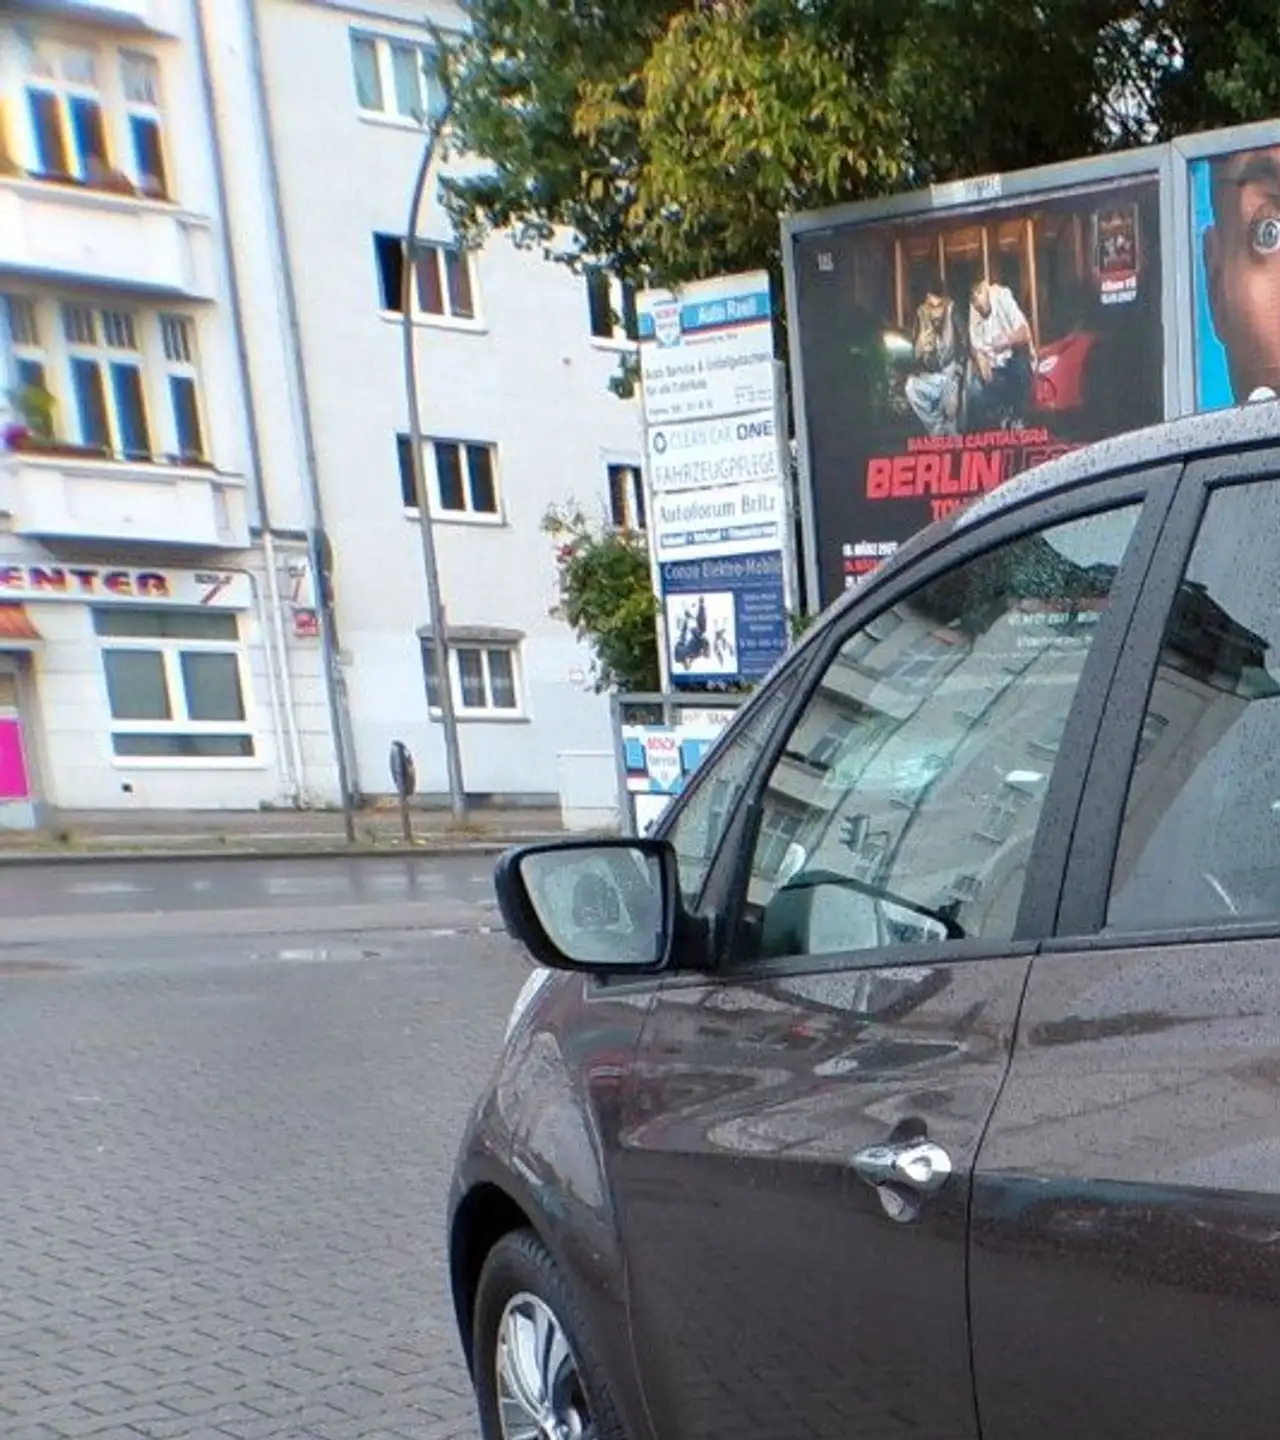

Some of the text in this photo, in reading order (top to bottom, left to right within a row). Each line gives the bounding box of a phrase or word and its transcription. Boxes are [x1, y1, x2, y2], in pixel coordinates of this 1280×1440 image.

[736, 419, 774, 441] ONE
[865, 450, 1001, 500] BERLIN
[659, 501, 736, 523] Autoforum
